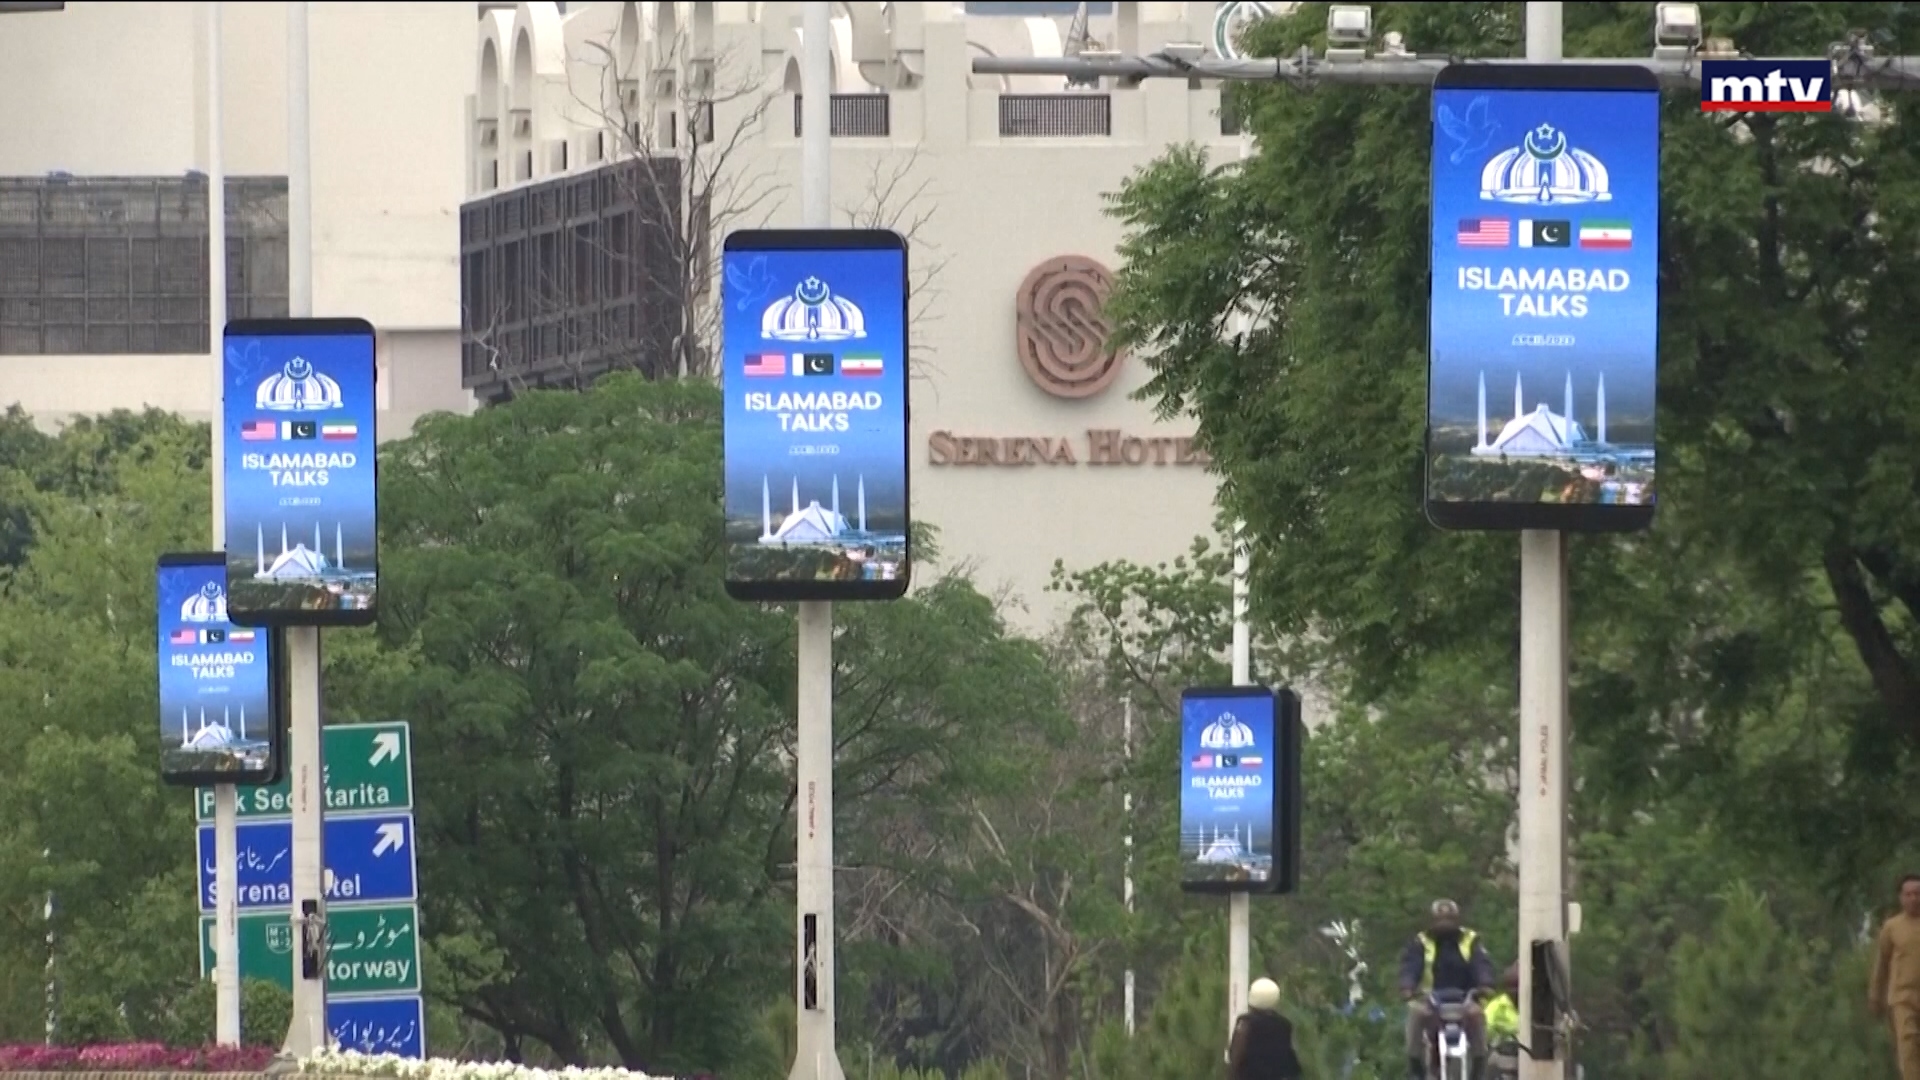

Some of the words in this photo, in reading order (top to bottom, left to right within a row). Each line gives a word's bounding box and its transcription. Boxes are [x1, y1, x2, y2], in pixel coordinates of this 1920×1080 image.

[1458, 266, 1630, 292] ISLAMABAD
[1499, 293, 1588, 317] TALKS
[745, 391, 882, 411] ISLAMABAD
[778, 412, 849, 432] TALKS
[242, 452, 357, 469] ISLAMABAD
[270, 470, 330, 487] TALKS
[171, 651, 255, 667] ISLAMABAD
[191, 666, 235, 679] TALKS
[1191, 774, 1262, 788] ISLAMABAD
[203, 791, 246, 814] Pk
[1208, 787, 1245, 799] TALKS
[208, 881, 290, 904] Srena
[327, 959, 411, 984] torway
